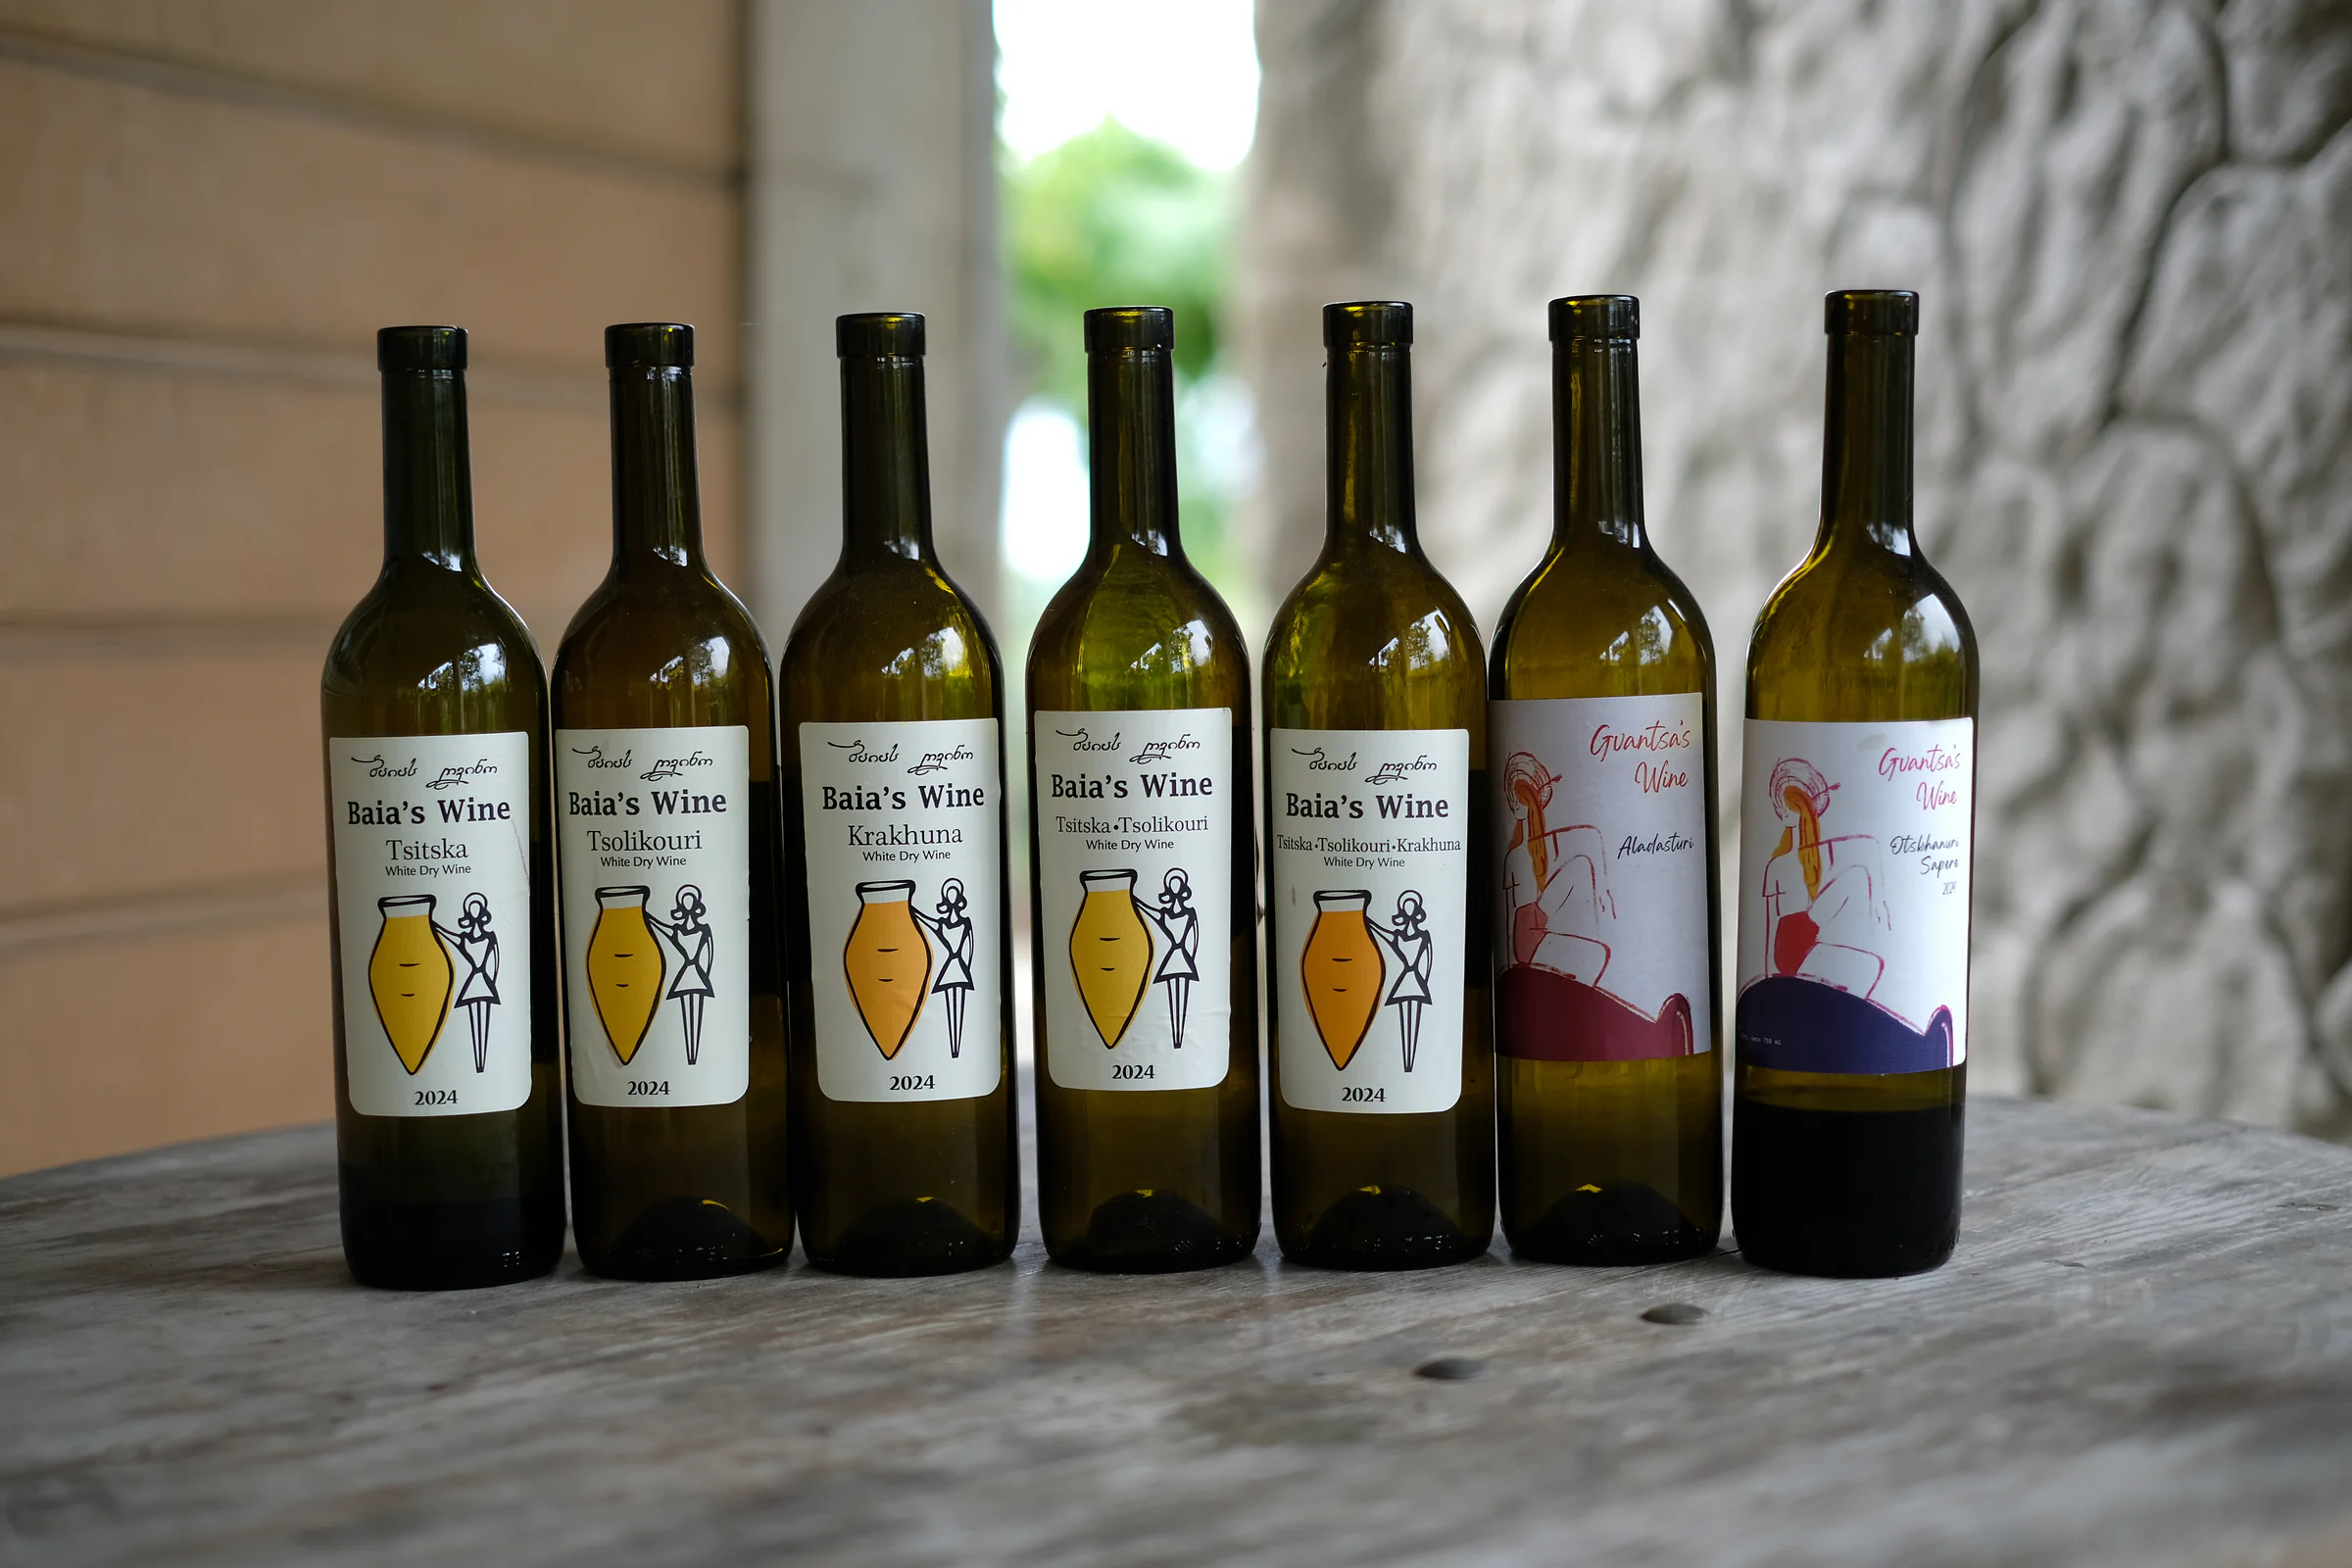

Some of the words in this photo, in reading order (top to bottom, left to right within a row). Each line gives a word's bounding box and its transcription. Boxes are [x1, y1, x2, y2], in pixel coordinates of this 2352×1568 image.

[1590, 719, 1690, 762] Gvantsa's
[1878, 743, 1961, 781] Gvantsa's
[1051, 772, 1129, 800] Baia's
[1139, 771, 1213, 799] Wine
[1634, 760, 1689, 794] Wine
[568, 790, 641, 816] Baia's
[650, 788, 727, 815] Wine
[821, 784, 906, 810] Baia's
[917, 782, 985, 809] Wine
[1286, 792, 1364, 819] Baia's
[1375, 793, 1449, 819] Wine
[1916, 780, 1957, 811] Wine
[347, 799, 426, 825] Baia's
[436, 796, 511, 824] Wine
[586, 829, 703, 852] Tsolikouri
[848, 823, 963, 847] Krakhuna
[1085, 838, 1118, 851] White
[1121, 840, 1142, 853] Dry
[1144, 838, 1175, 850] Wine
[1616, 832, 1694, 860] Aladasturi
[385, 837, 469, 860] Tsitska
[861, 850, 897, 862] White
[900, 851, 919, 863] Dry
[921, 849, 952, 860] Wine
[384, 864, 417, 877] White
[419, 865, 439, 878] Dry
[441, 863, 471, 875] Wine
[600, 856, 631, 867] White
[634, 857, 654, 869] Dry
[656, 855, 687, 866] Wine
[1323, 856, 1353, 867] White
[1356, 858, 1375, 869] Dry
[1377, 857, 1405, 867] Wine
[1919, 855, 1960, 879] Sapere
[889, 1074, 936, 1091] 2024
[1111, 1064, 1156, 1080] 2024
[415, 1089, 460, 1105] 2024
[627, 1080, 671, 1096] 2024
[1342, 1086, 1387, 1102] 2024
